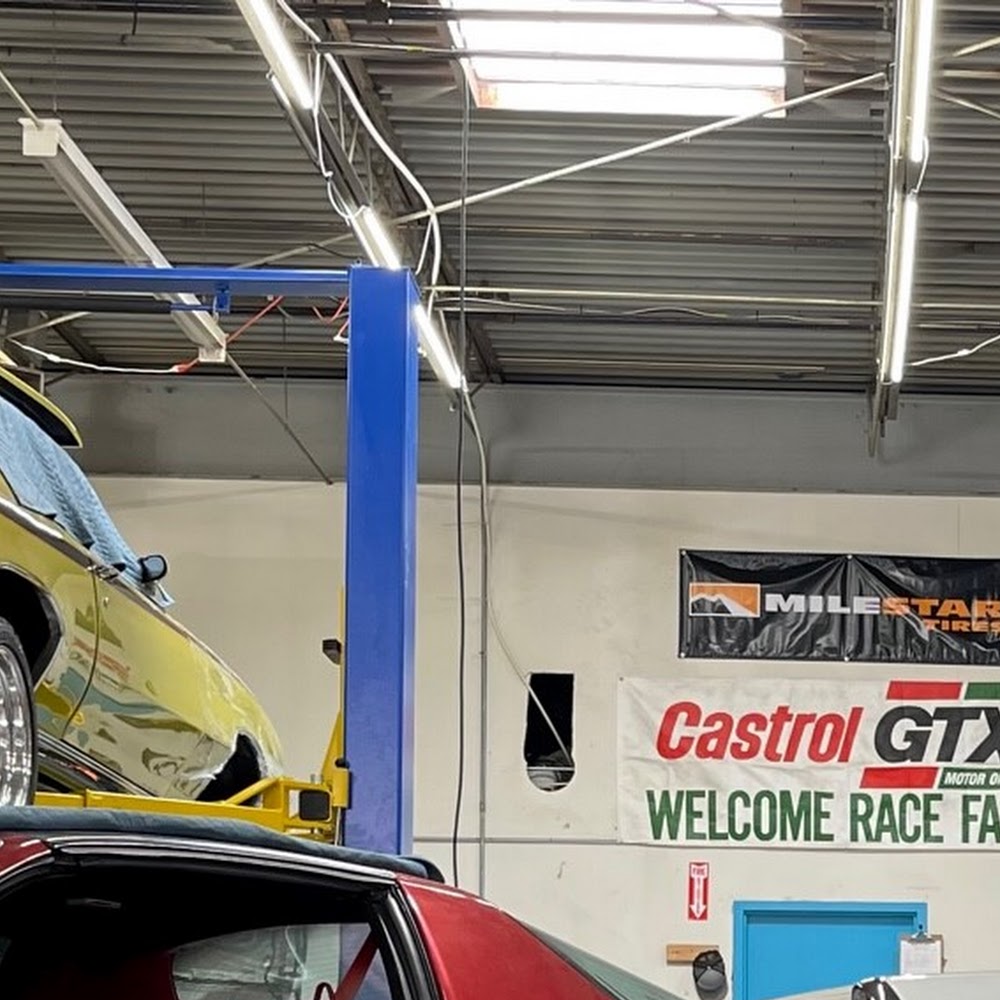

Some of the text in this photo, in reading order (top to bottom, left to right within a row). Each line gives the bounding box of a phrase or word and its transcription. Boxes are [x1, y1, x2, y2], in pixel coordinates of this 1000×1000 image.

[656, 701, 864, 764] Castrol
[944, 772, 986, 786] MOTOR
[646, 790, 835, 842] WELCOME
[849, 793, 944, 844] RACE
